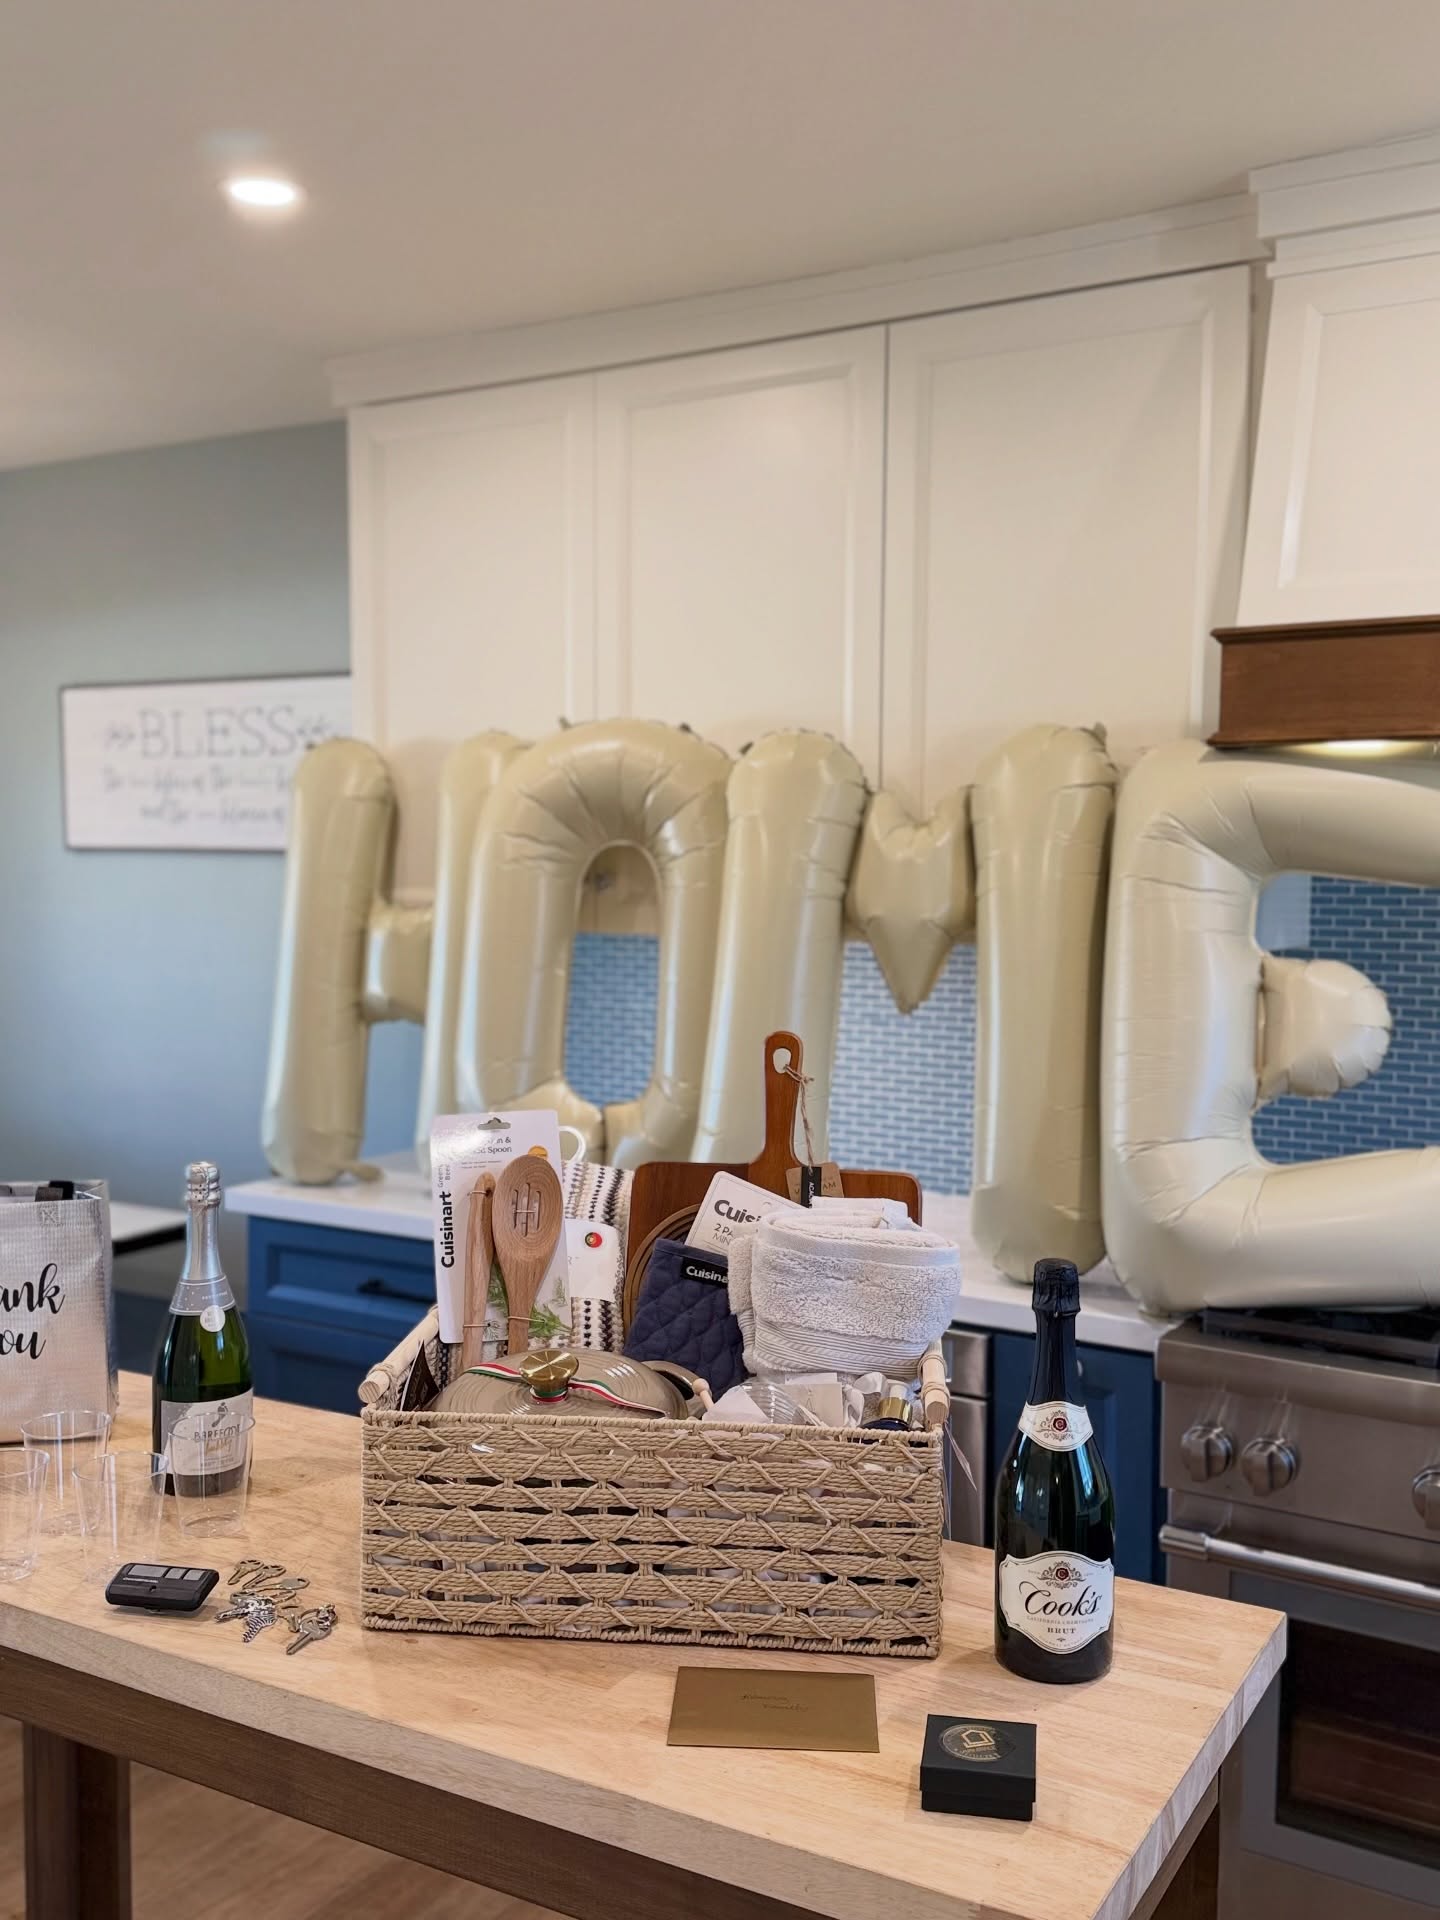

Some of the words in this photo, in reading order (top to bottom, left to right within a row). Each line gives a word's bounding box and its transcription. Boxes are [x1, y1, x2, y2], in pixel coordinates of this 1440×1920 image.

[138, 704, 299, 760] BLESS
[487, 1146, 512, 1154] Spoon
[439, 1191, 455, 1268] Cuisinart
[1018, 1581, 1102, 1616] Cook's
[1047, 1627, 1077, 1635] BRUT
